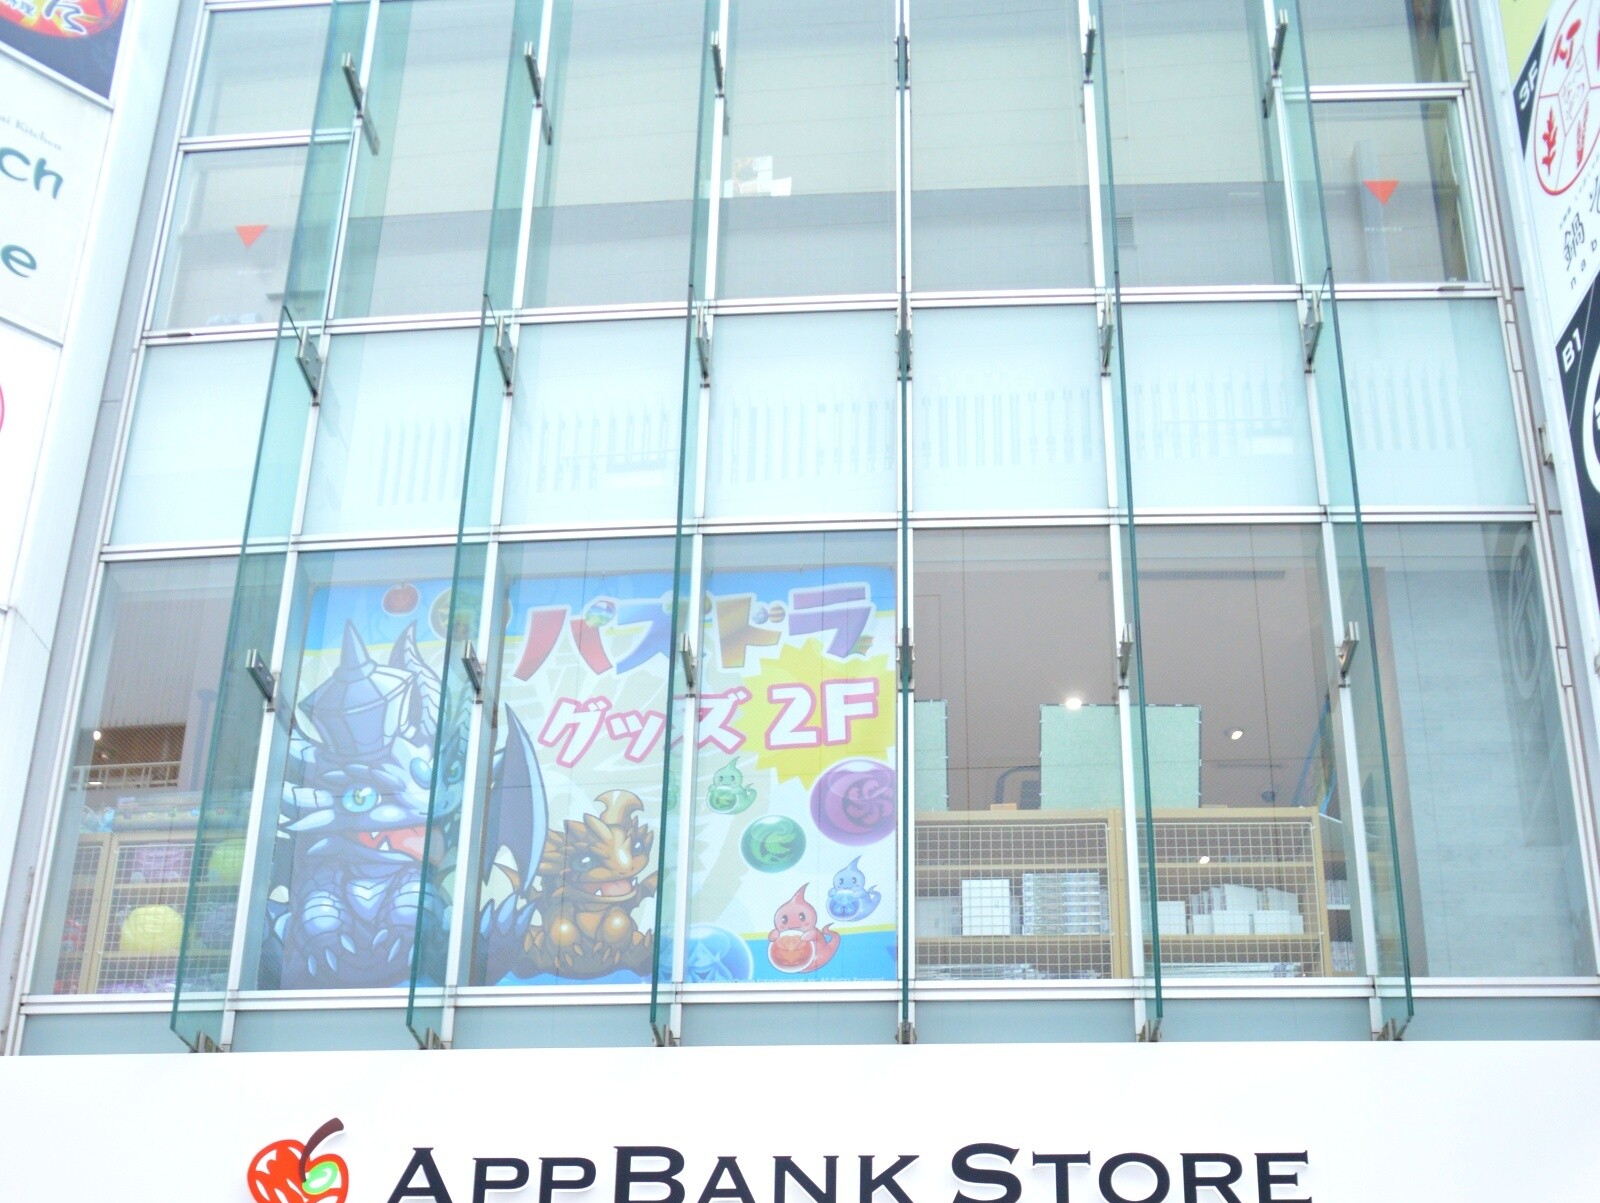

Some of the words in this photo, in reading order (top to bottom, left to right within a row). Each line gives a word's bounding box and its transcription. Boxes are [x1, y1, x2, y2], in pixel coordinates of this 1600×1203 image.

[1519, 59, 1539, 111] 3F
[1562, 327, 1582, 373] B1
[512, 585, 873, 682] パズドラ
[537, 686, 752, 768] グッズ
[765, 677, 880, 750] 2F
